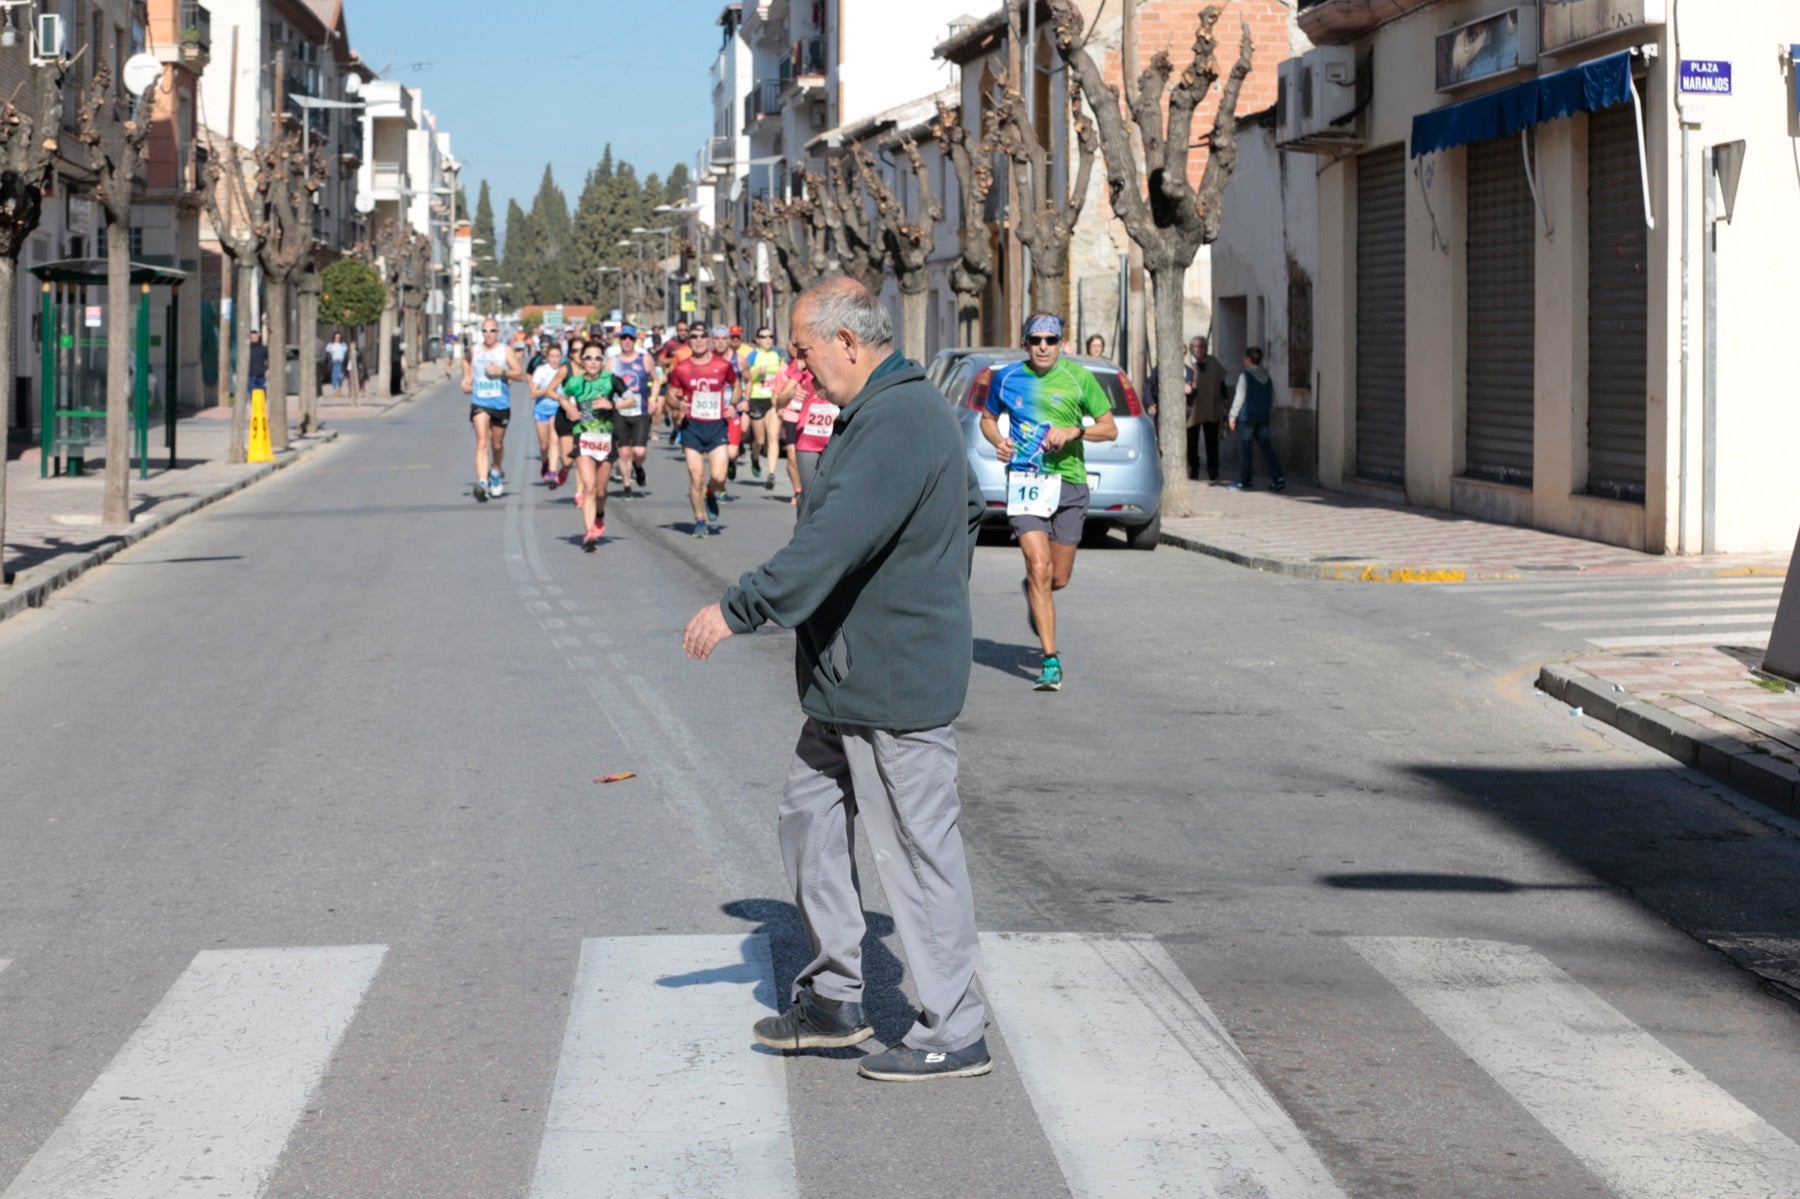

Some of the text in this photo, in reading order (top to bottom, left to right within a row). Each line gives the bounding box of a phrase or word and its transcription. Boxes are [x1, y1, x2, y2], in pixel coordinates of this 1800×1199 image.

[1690, 62, 1719, 73] PLAZA
[1682, 76, 1729, 92] NARANJOS
[1018, 486, 1039, 501] 16
